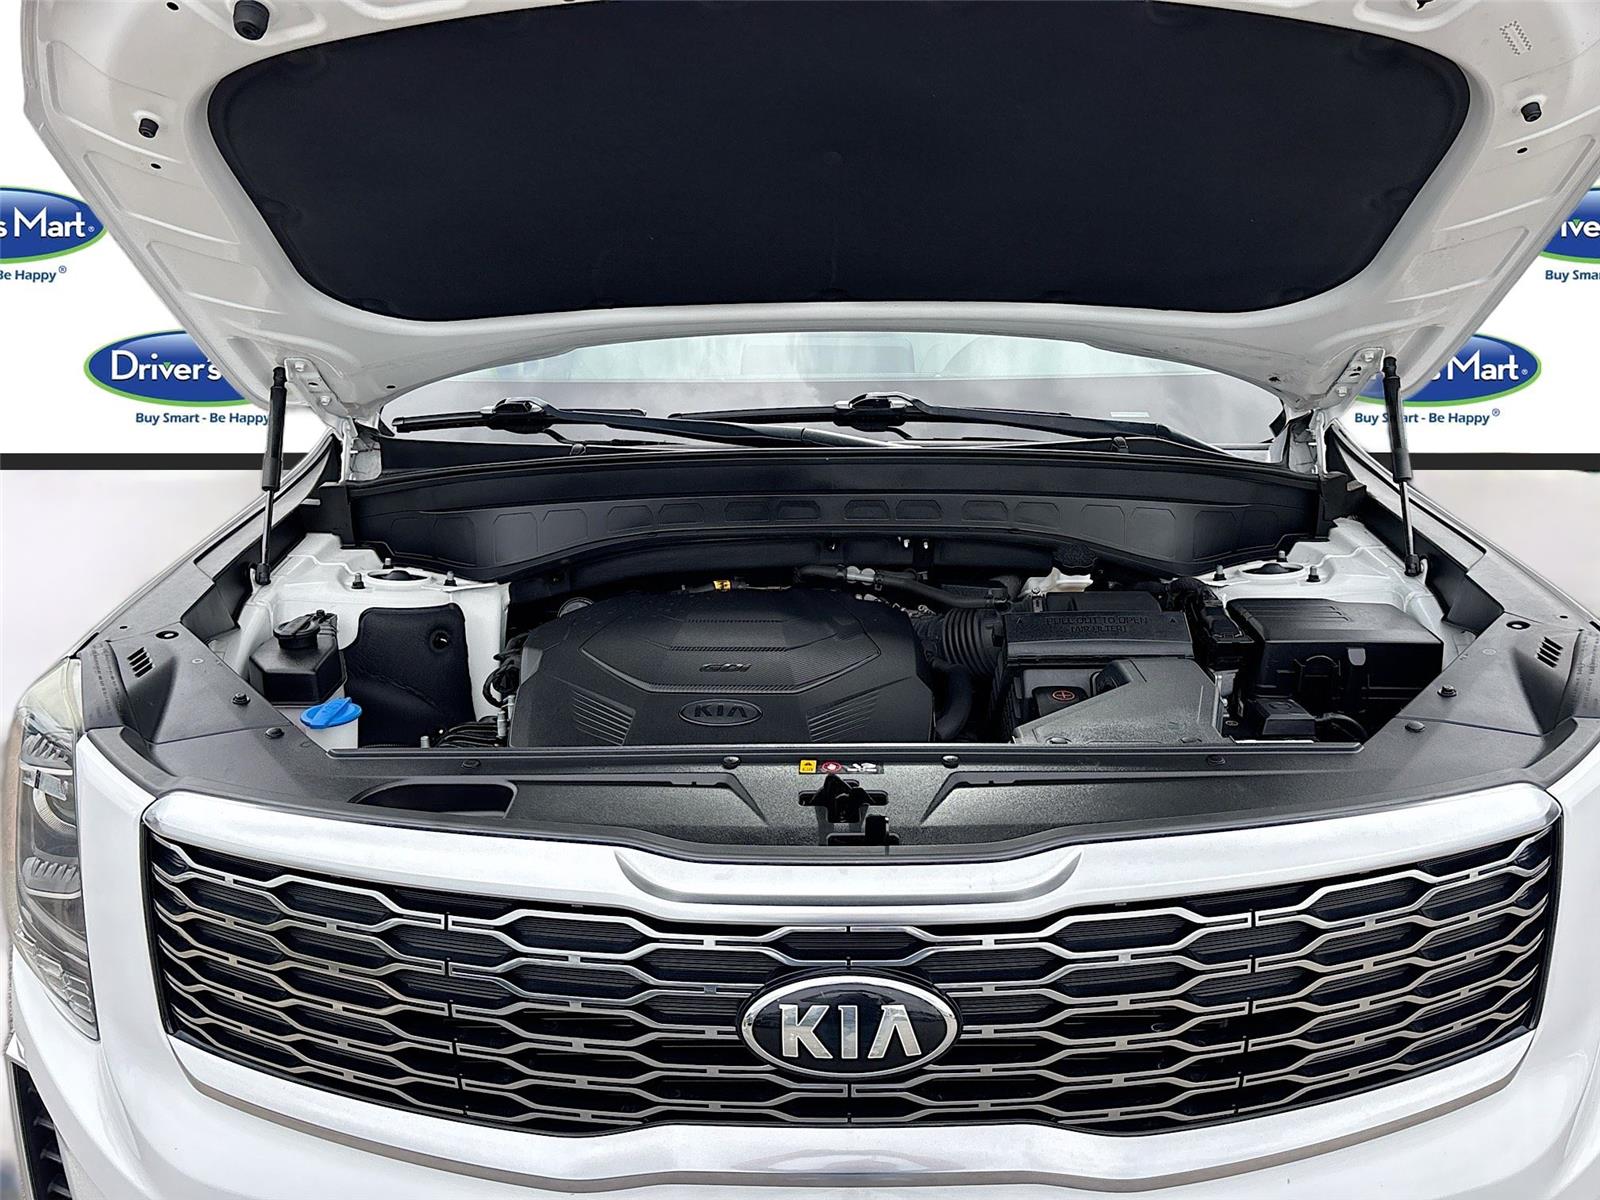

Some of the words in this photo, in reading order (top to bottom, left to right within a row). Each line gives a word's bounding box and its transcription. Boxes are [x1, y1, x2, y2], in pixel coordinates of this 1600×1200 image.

[14, 206, 86, 238] Mart
[15, 270, 57, 283] Happy
[1545, 269, 1570, 283] Buy
[111, 349, 222, 380] Drivers
[1447, 350, 1520, 380] Mart
[135, 413, 160, 426] Buy
[162, 412, 200, 423] Smart
[209, 413, 226, 423] Be
[229, 413, 268, 426] Happy
[1354, 413, 1379, 426] Buy
[1381, 412, 1419, 423] Sart
[1429, 413, 1445, 423] Be
[1448, 413, 1490, 426] Happy
[694, 704, 748, 718] KIA
[778, 1003, 923, 1060] KIA
